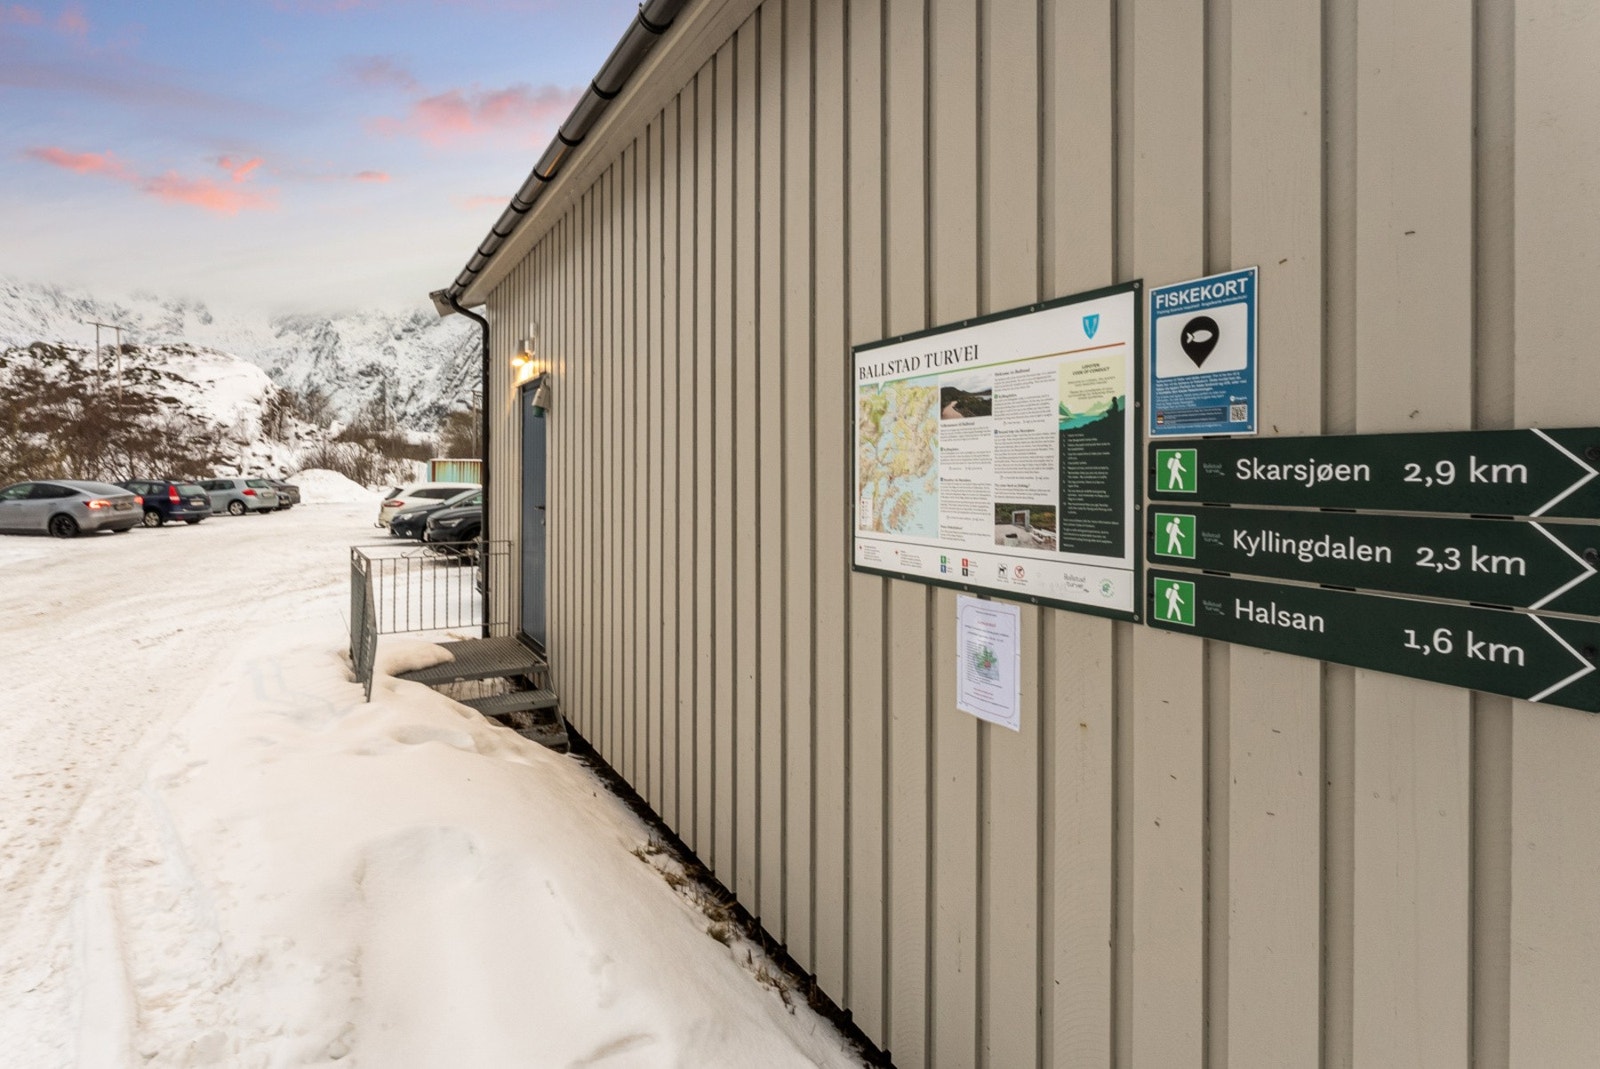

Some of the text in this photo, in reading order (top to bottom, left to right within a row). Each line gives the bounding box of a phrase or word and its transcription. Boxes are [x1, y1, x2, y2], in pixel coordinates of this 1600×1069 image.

[1155, 278, 1249, 310] FISKEKORT
[859, 344, 980, 381] BALLSTAD TURVEI
[1235, 456, 1528, 488] Skarsjøen 2,9 km
[1233, 530, 1526, 577] Kyllingdalen 2,3 km
[1234, 599, 1525, 667] Halsan 1,6 km
